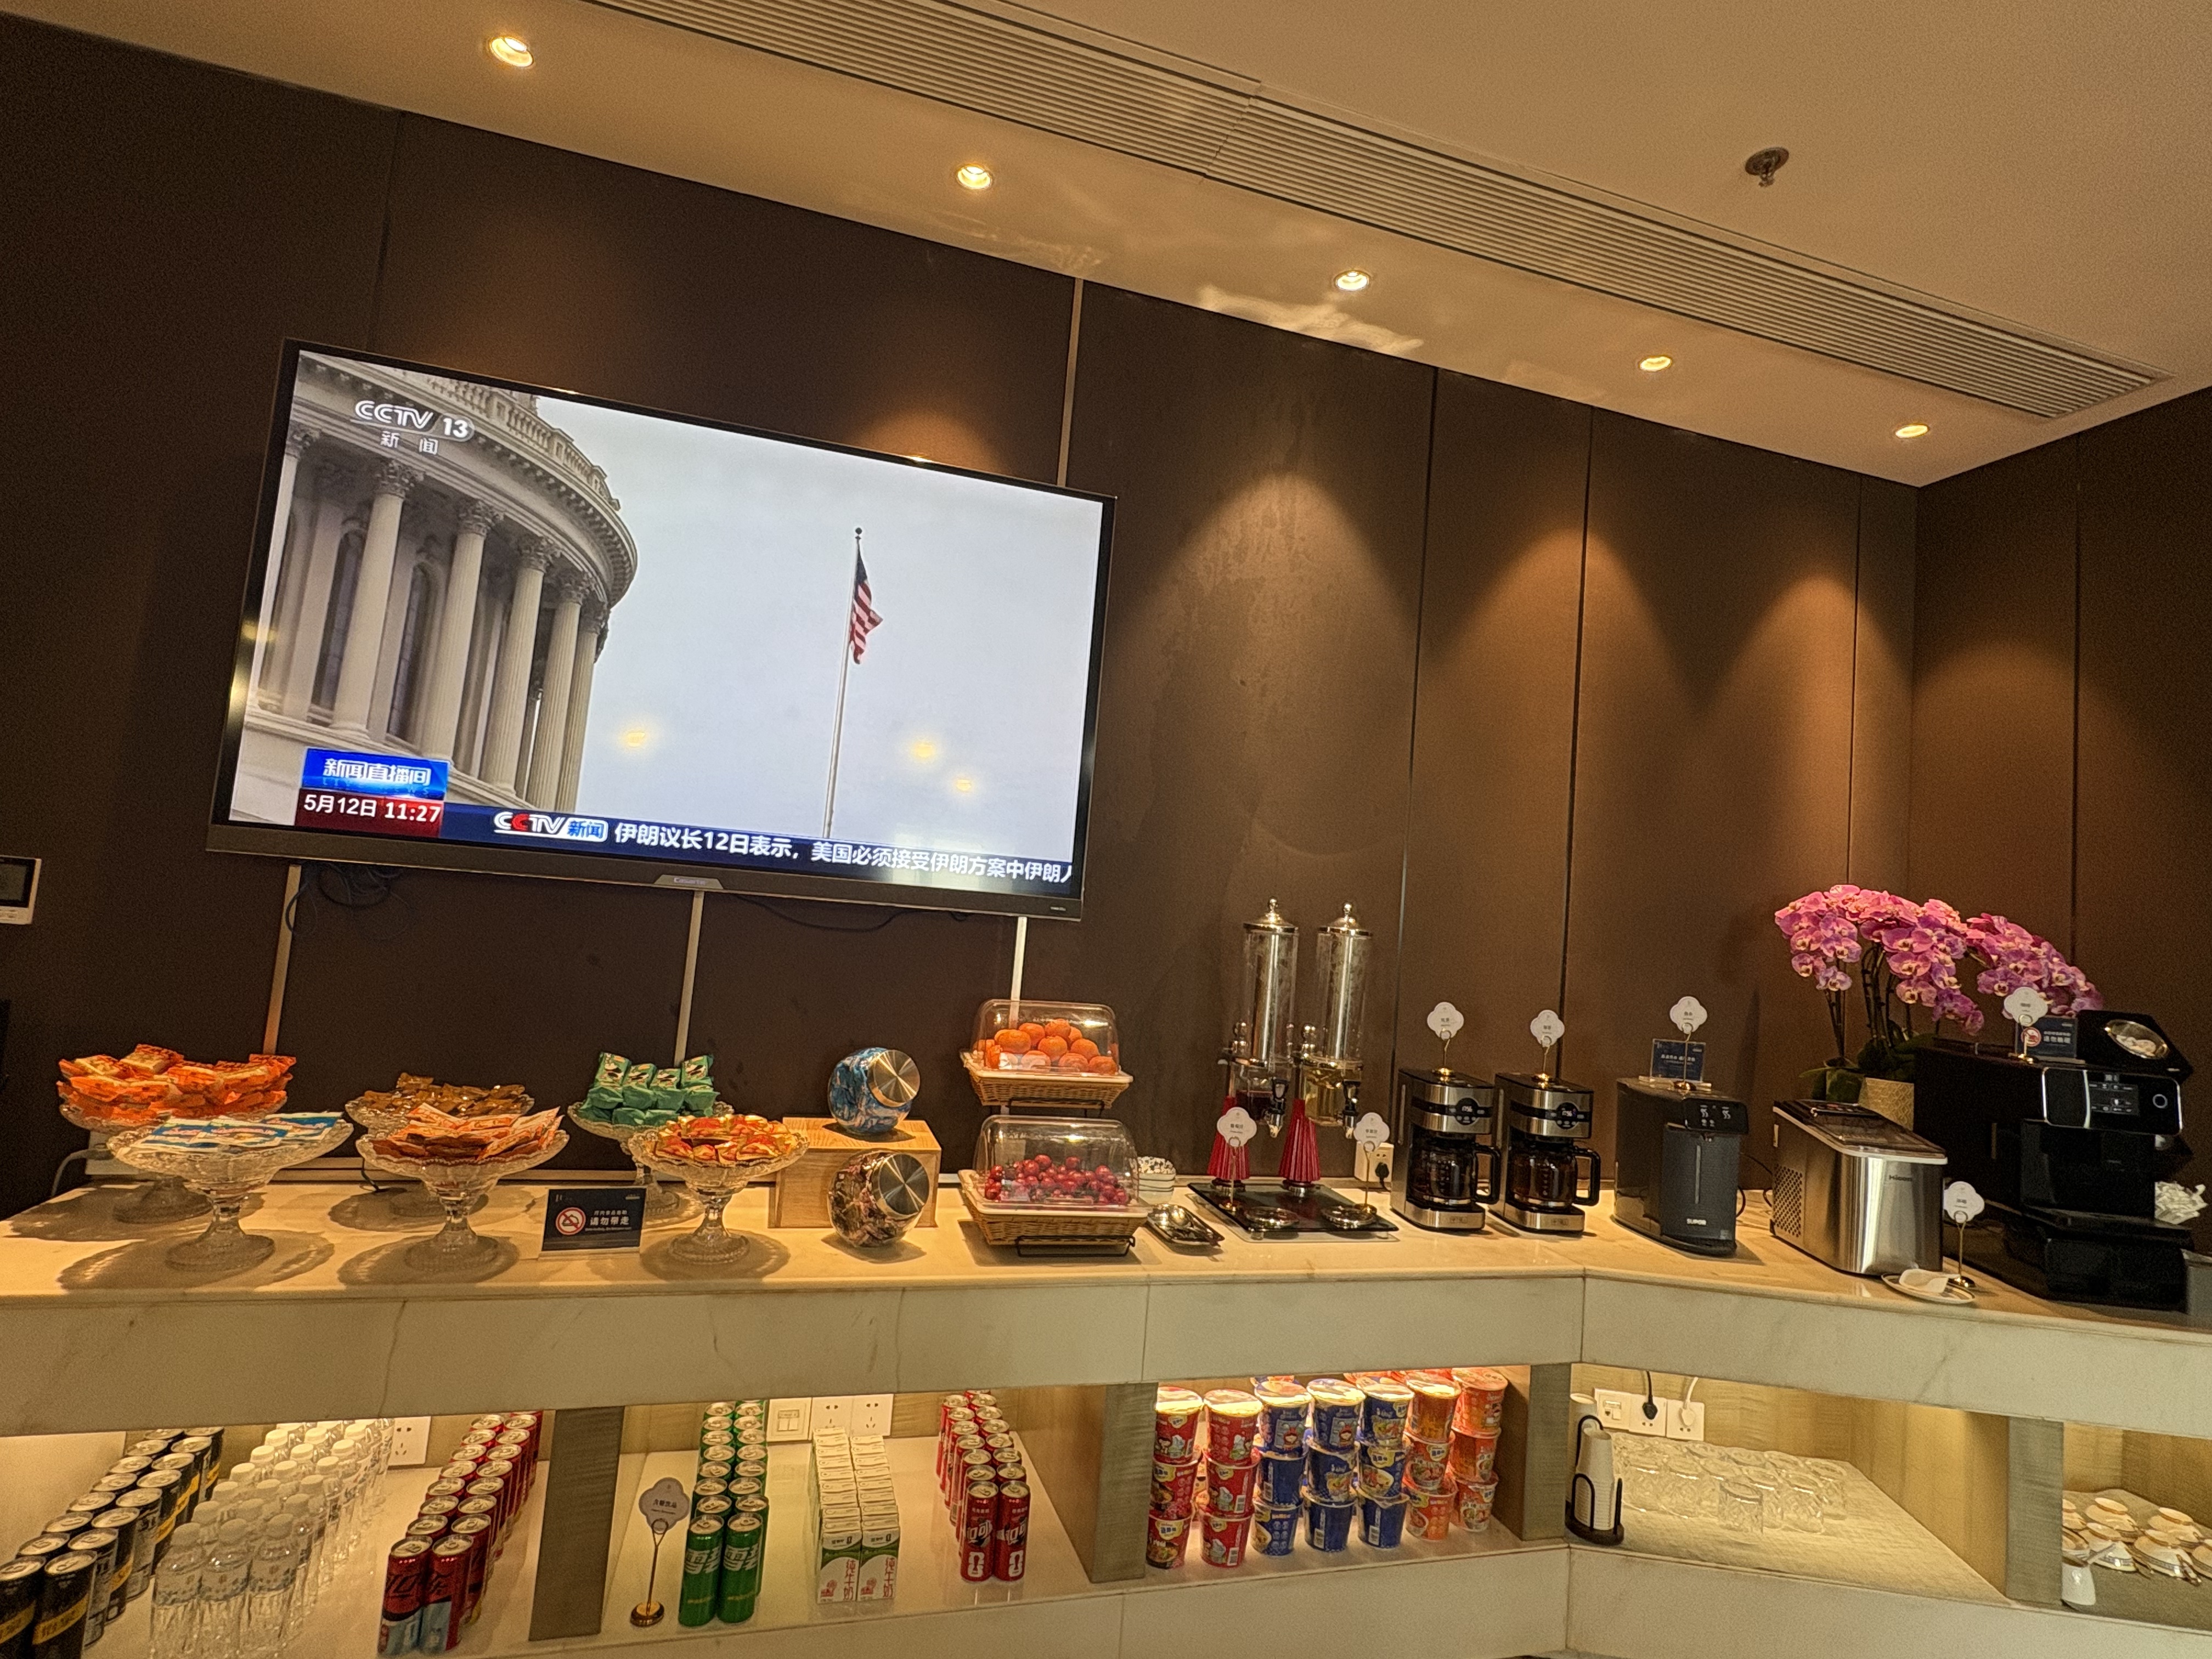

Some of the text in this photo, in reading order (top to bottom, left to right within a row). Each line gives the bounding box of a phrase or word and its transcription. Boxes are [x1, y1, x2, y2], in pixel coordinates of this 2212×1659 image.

[355, 400, 469, 438] CCTV 13
[380, 430, 438, 455] 新闻
[323, 758, 432, 786] 新闻直播间
[304, 794, 441, 823] 5月12日 11:27
[494, 811, 605, 839] CCTV 新闻
[843, 1559, 856, 1601] 纯牛奶
[883, 1556, 896, 1598] 纯牛奶
